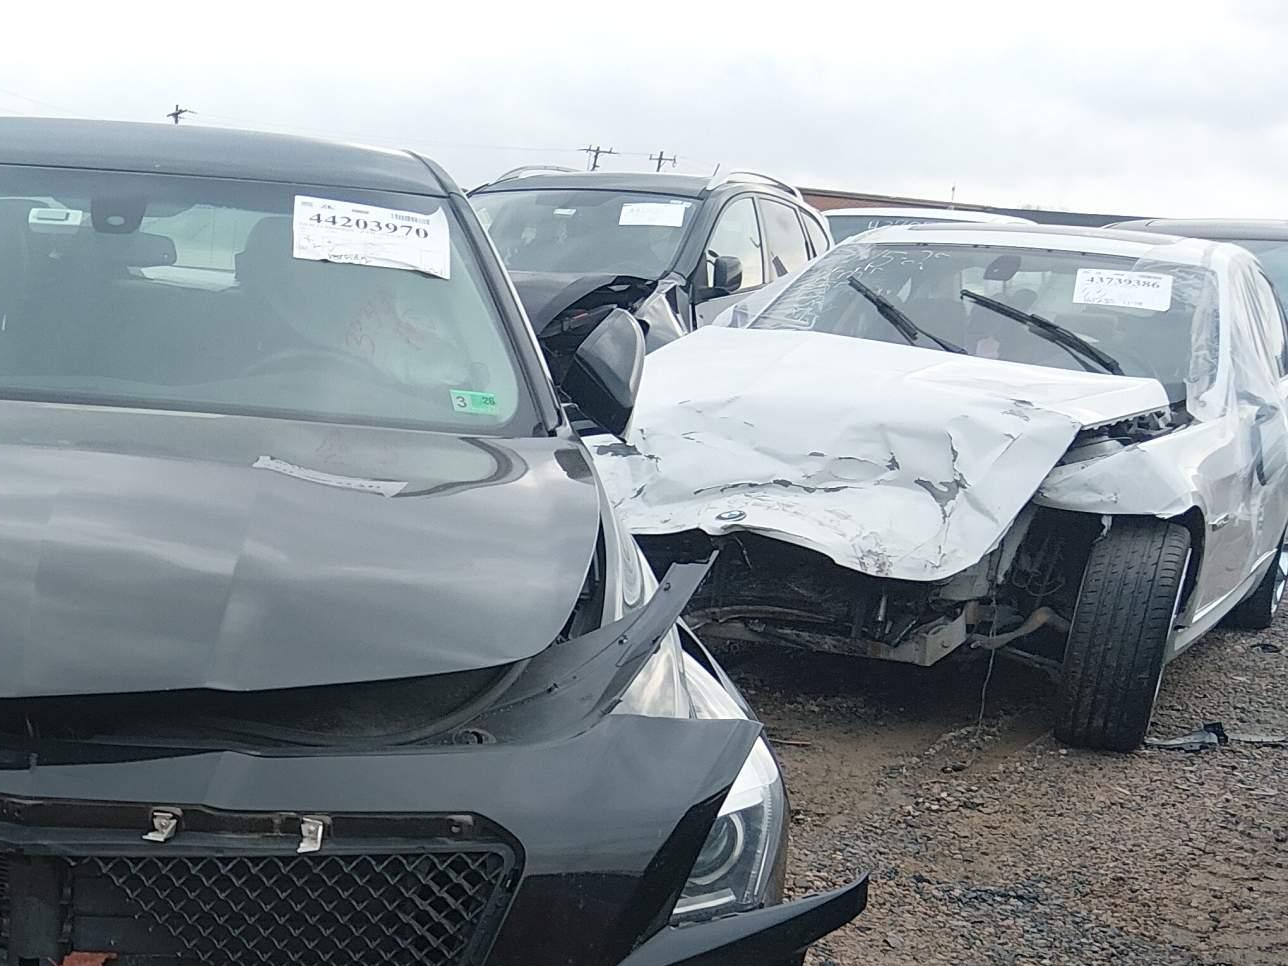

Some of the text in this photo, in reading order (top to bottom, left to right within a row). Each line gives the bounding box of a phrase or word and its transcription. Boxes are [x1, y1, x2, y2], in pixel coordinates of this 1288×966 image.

[309, 212, 429, 239] 44203970
[1085, 276, 1161, 289] 43739386
[456, 395, 468, 408] 3
